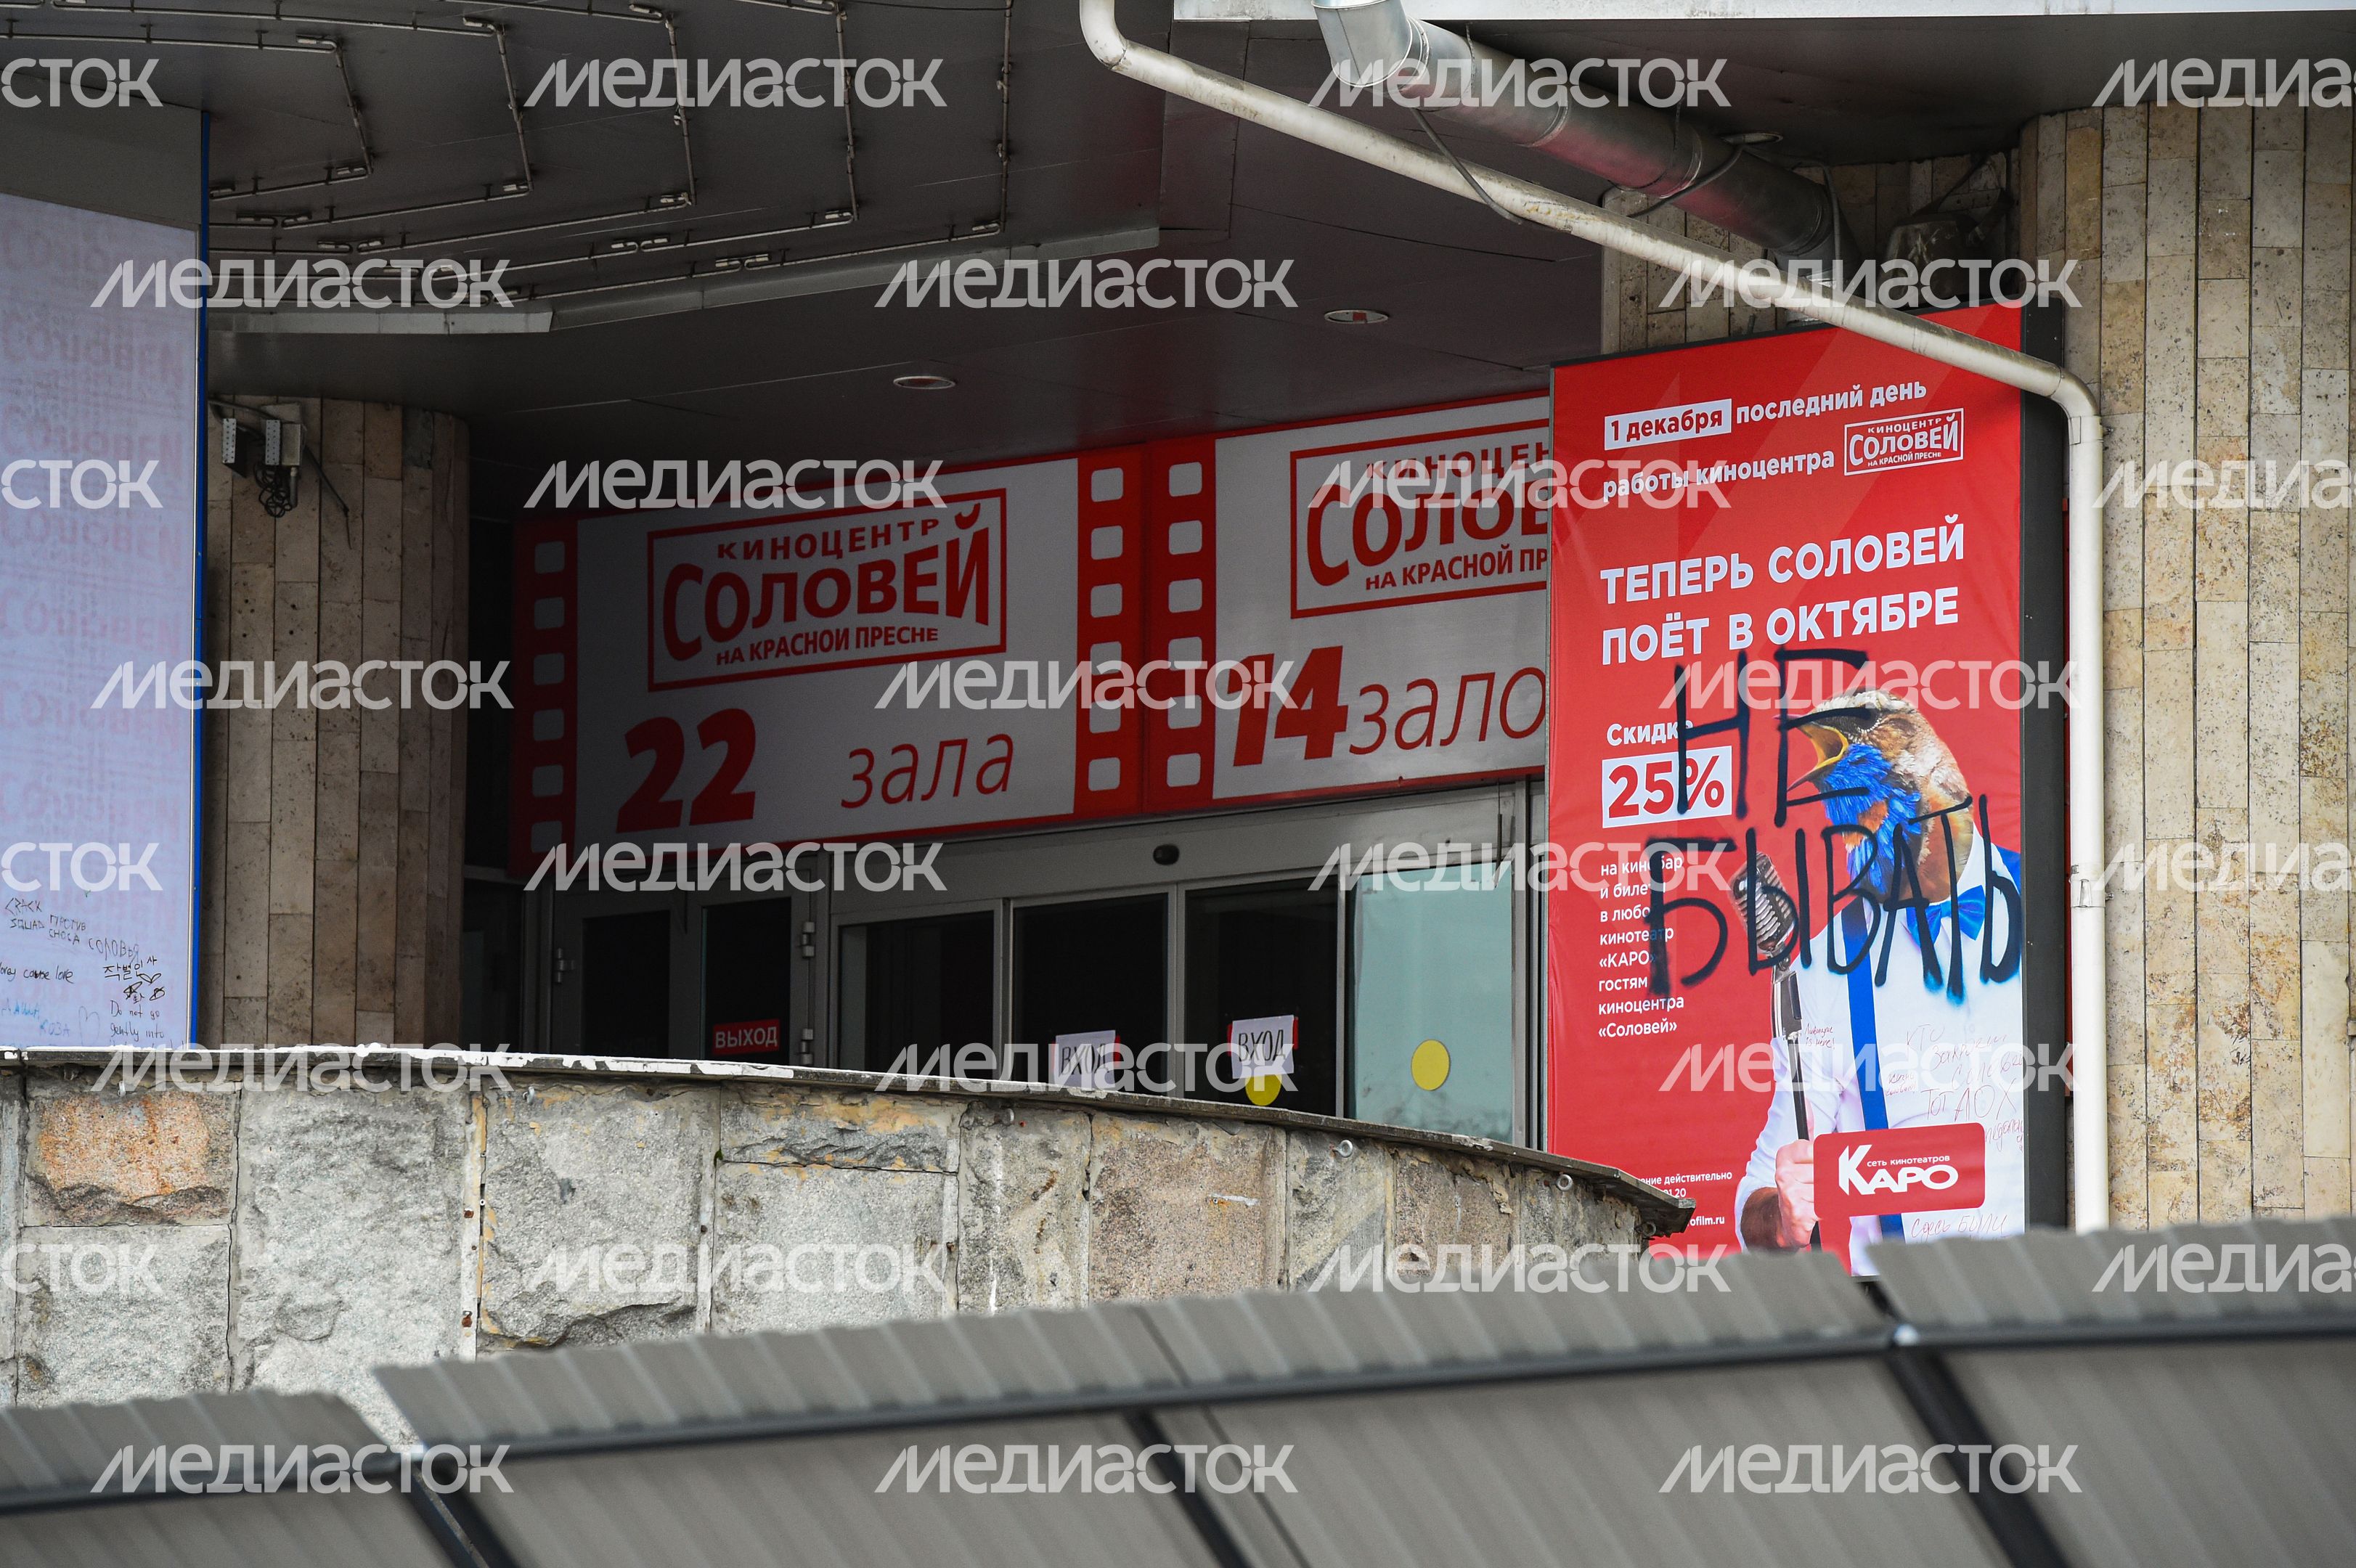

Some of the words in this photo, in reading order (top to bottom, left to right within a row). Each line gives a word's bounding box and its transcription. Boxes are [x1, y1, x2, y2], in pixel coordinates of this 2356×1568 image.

[1611, 420, 1619, 441] 1
[1626, 409, 1723, 443] декабря
[1736, 383, 1864, 424] последний
[1870, 380, 1927, 408] день
[1867, 417, 1942, 434] КИНОЦЕНТР
[1879, 452, 1913, 465] КРАСНОЙ
[1914, 451, 1942, 461] ПРЕСНЕ
[1603, 470, 1689, 503] работы
[1695, 449, 1835, 486] киноцентра
[717, 518, 940, 560] КИНОЦЕНТР
[1365, 571, 1398, 591] НА
[1401, 544, 1513, 586] КРАСНОЙ
[1600, 552, 1754, 605] ТЕПЕРЬ
[1768, 514, 1965, 584] СОЛОВЕЙ
[1602, 612, 1711, 666] ПОЁТ
[1729, 613, 1753, 651] В
[1766, 587, 1959, 646] ОКТЯБРЕ
[715, 648, 745, 666] НА
[855, 625, 939, 650] ПРЕСНЕ
[1227, 645, 1349, 767] 14
[1675, 645, 1868, 828] НЕ
[615, 707, 758, 835] 22
[839, 732, 1014, 809] зала
[1608, 755, 1725, 819] 25%
[1600, 863, 1618, 877] на
[1622, 855, 1683, 874] кинар
[1599, 886, 1609, 899] и
[1613, 882, 1666, 899] биле
[1645, 794, 2023, 1005] БЫВАТЬ
[1599, 910, 1608, 923] в
[1611, 904, 1652, 922] любо
[1598, 975, 1648, 992] гостям
[129, 1005, 144, 1020] not
[149, 1010, 160, 1021] go
[1597, 994, 1685, 1016] киноцентра
[715, 1026, 778, 1049] ВЫХОД
[1597, 1016, 1678, 1039] «Соловей»
[1060, 1043, 1110, 1077] ВХОД
[1238, 1029, 1287, 1063] ВХОД
[1838, 1143, 1960, 1196] КАРО
[1890, 1155, 1951, 1166] кинотеатров
[1663, 1171, 1733, 1185] действительно
